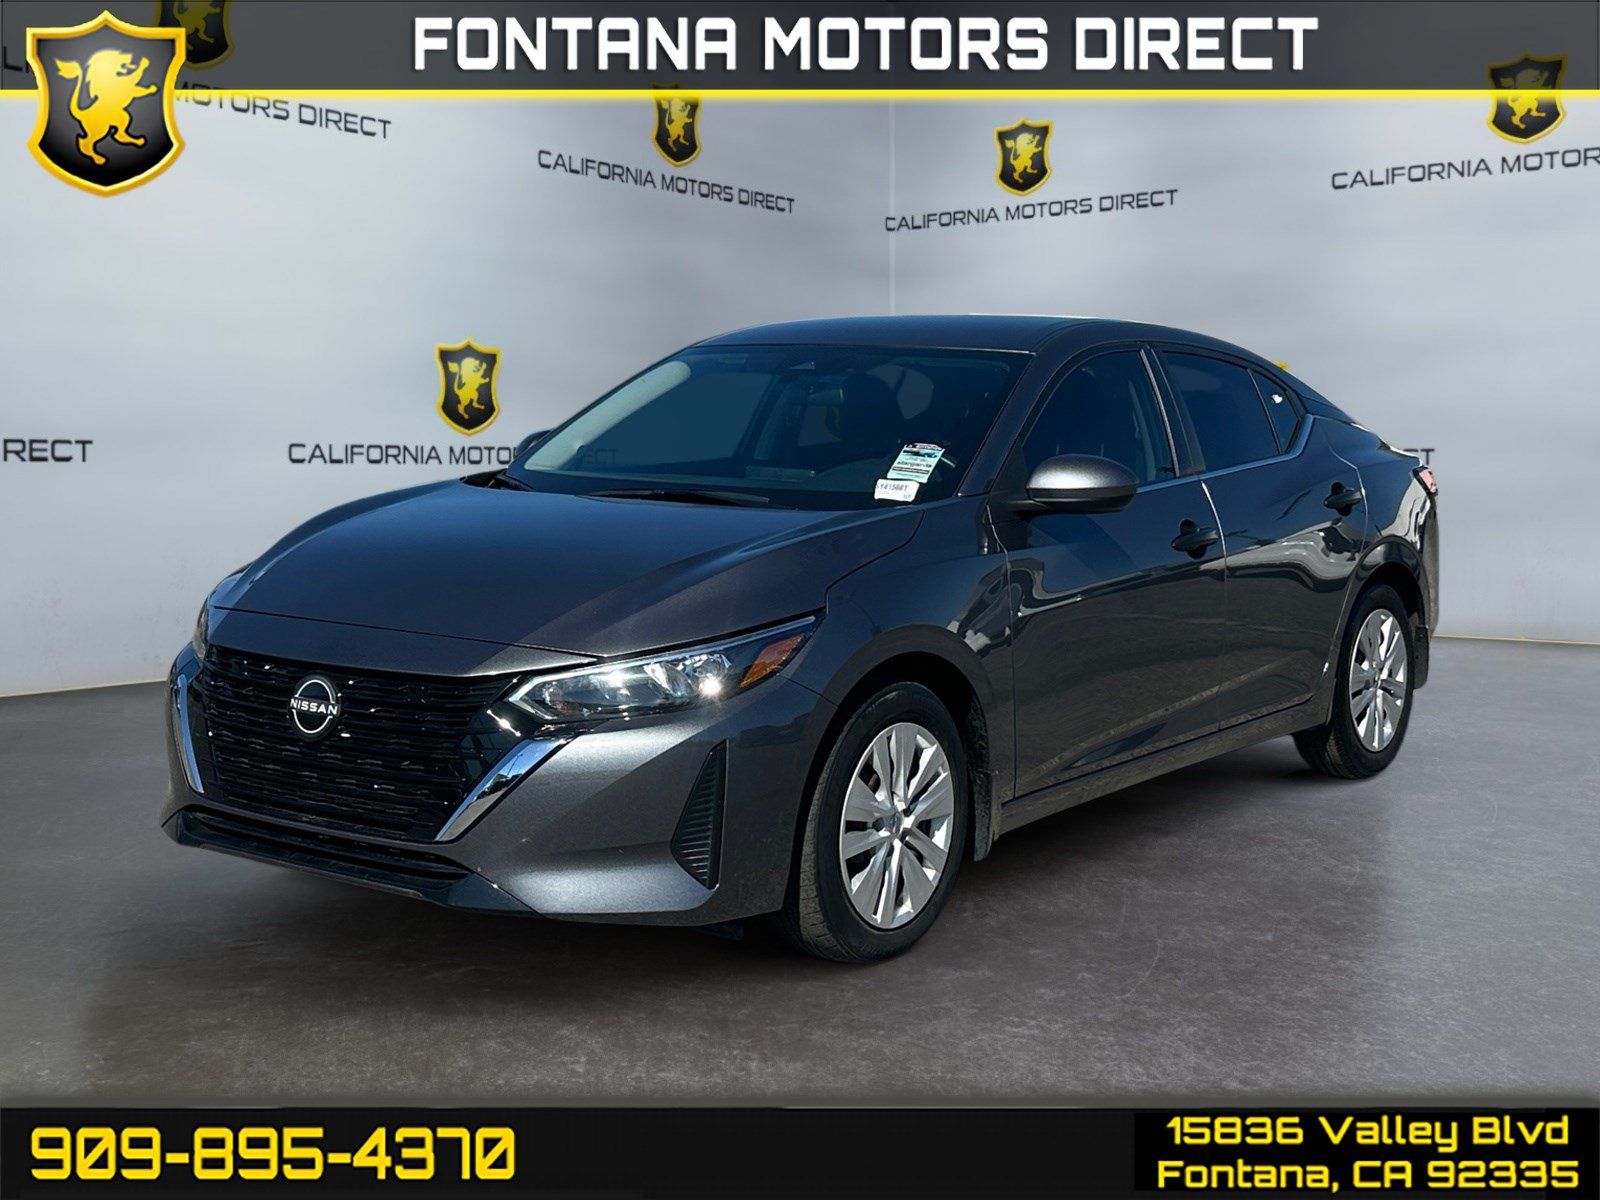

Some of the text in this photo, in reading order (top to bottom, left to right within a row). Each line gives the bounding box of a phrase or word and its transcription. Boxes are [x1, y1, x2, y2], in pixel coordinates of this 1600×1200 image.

[298, 103, 392, 139] DIRECT
[537, 149, 796, 215] CALIFORNIA MOTORS DIRECT
[1331, 158, 1493, 190] CALIFORNIA
[884, 188, 1179, 232] CALIFORNIA MOTORS DIRECT
[288, 443, 443, 465] CALIFORNIA
[290, 698, 338, 715] NISSAN
